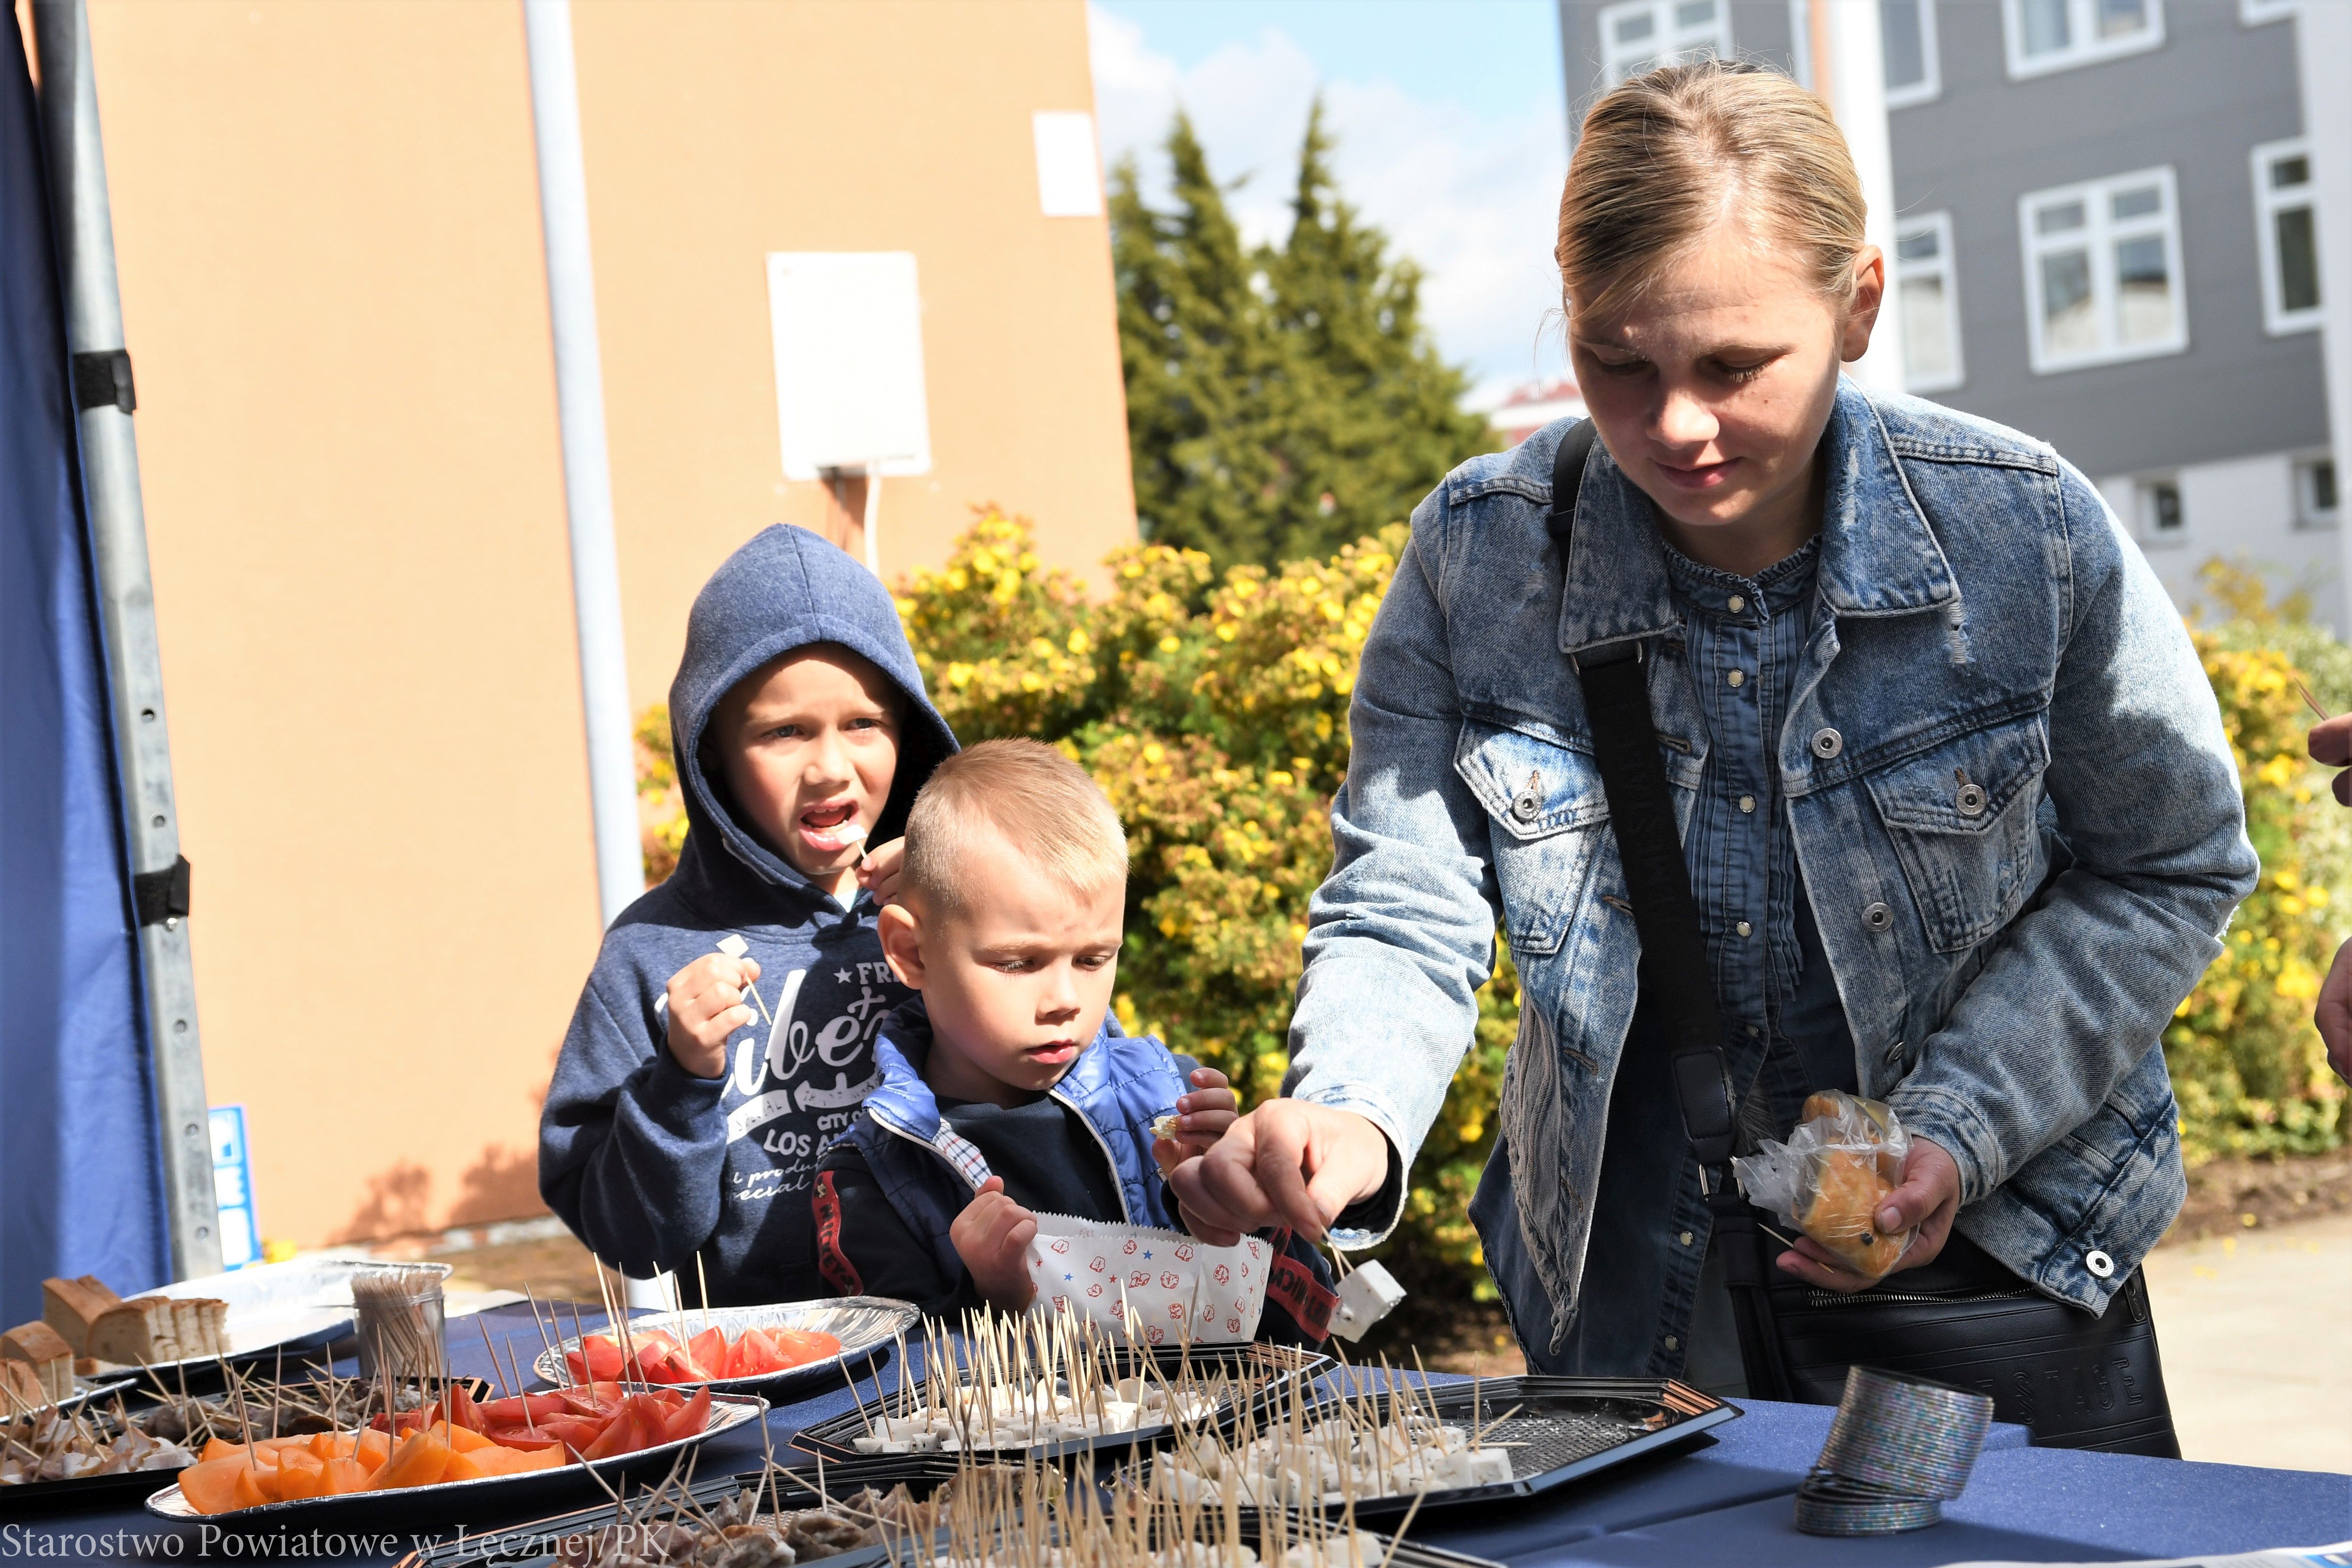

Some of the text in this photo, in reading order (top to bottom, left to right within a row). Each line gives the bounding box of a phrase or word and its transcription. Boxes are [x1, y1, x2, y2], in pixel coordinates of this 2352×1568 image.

[851, 1110, 863, 1123] O
[763, 1128, 811, 1157] LOS
[734, 1174, 810, 1200] ecial
[819, 1204, 847, 1275] MICKEY
